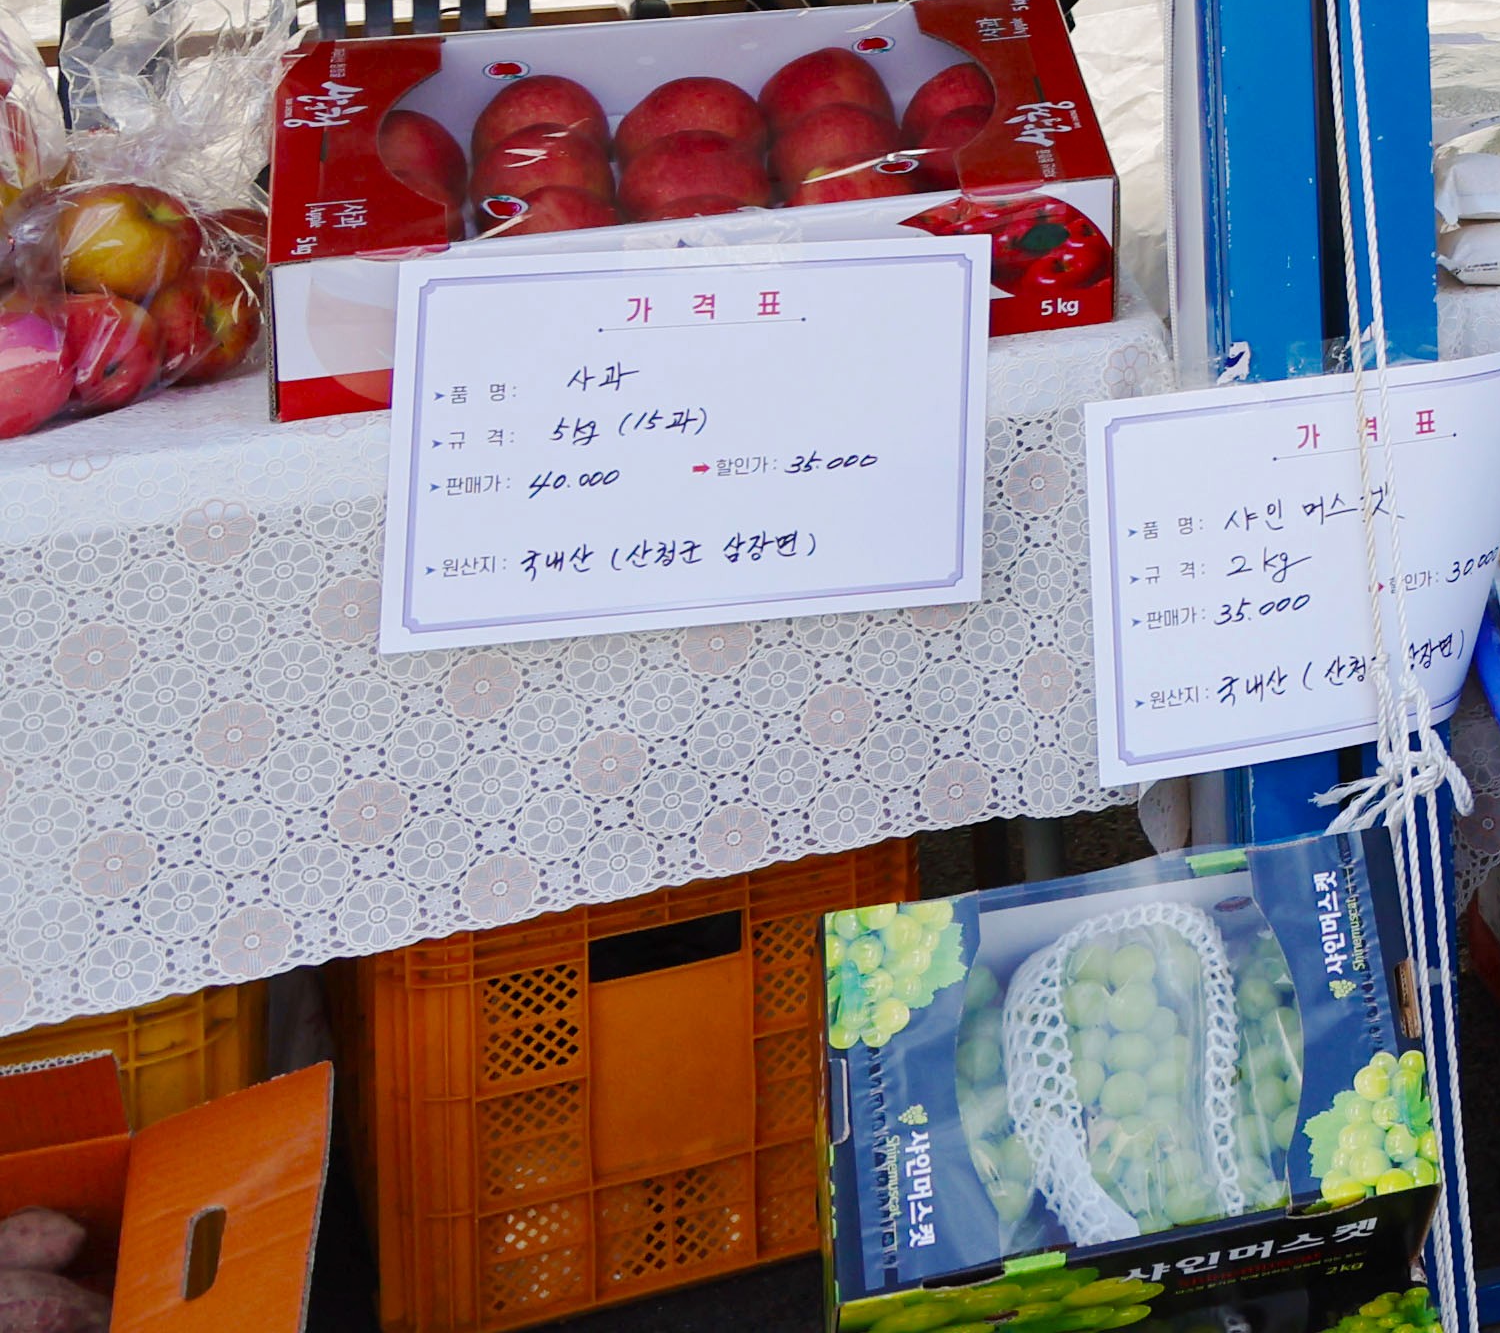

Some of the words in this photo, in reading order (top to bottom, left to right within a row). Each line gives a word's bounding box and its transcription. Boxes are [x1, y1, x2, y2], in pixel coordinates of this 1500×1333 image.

[975, 17, 1006, 38] 사과
[1009, 16, 1028, 35] Apple
[303, 206, 328, 229] Apple
[332, 202, 369, 229] 사과
[567, 361, 640, 392] 사과
[617, 406, 709, 436] (15과)
[783, 451, 881, 476] 35.000
[528, 468, 622, 500] 40.000
[1223, 498, 1285, 533] 샤인
[520, 545, 595, 583] 국내산
[1213, 594, 1311, 626] 35.000
[1216, 665, 1289, 706] 국내산
[1313, 870, 1348, 975] 샤인머스켓
[1346, 896, 1366, 972] Shinemuscat
[886, 1134, 902, 1218] Shinemuscat
[905, 1130, 936, 1249] 샤인머스켓
[1120, 1216, 1379, 1283] 샤인머스켓
